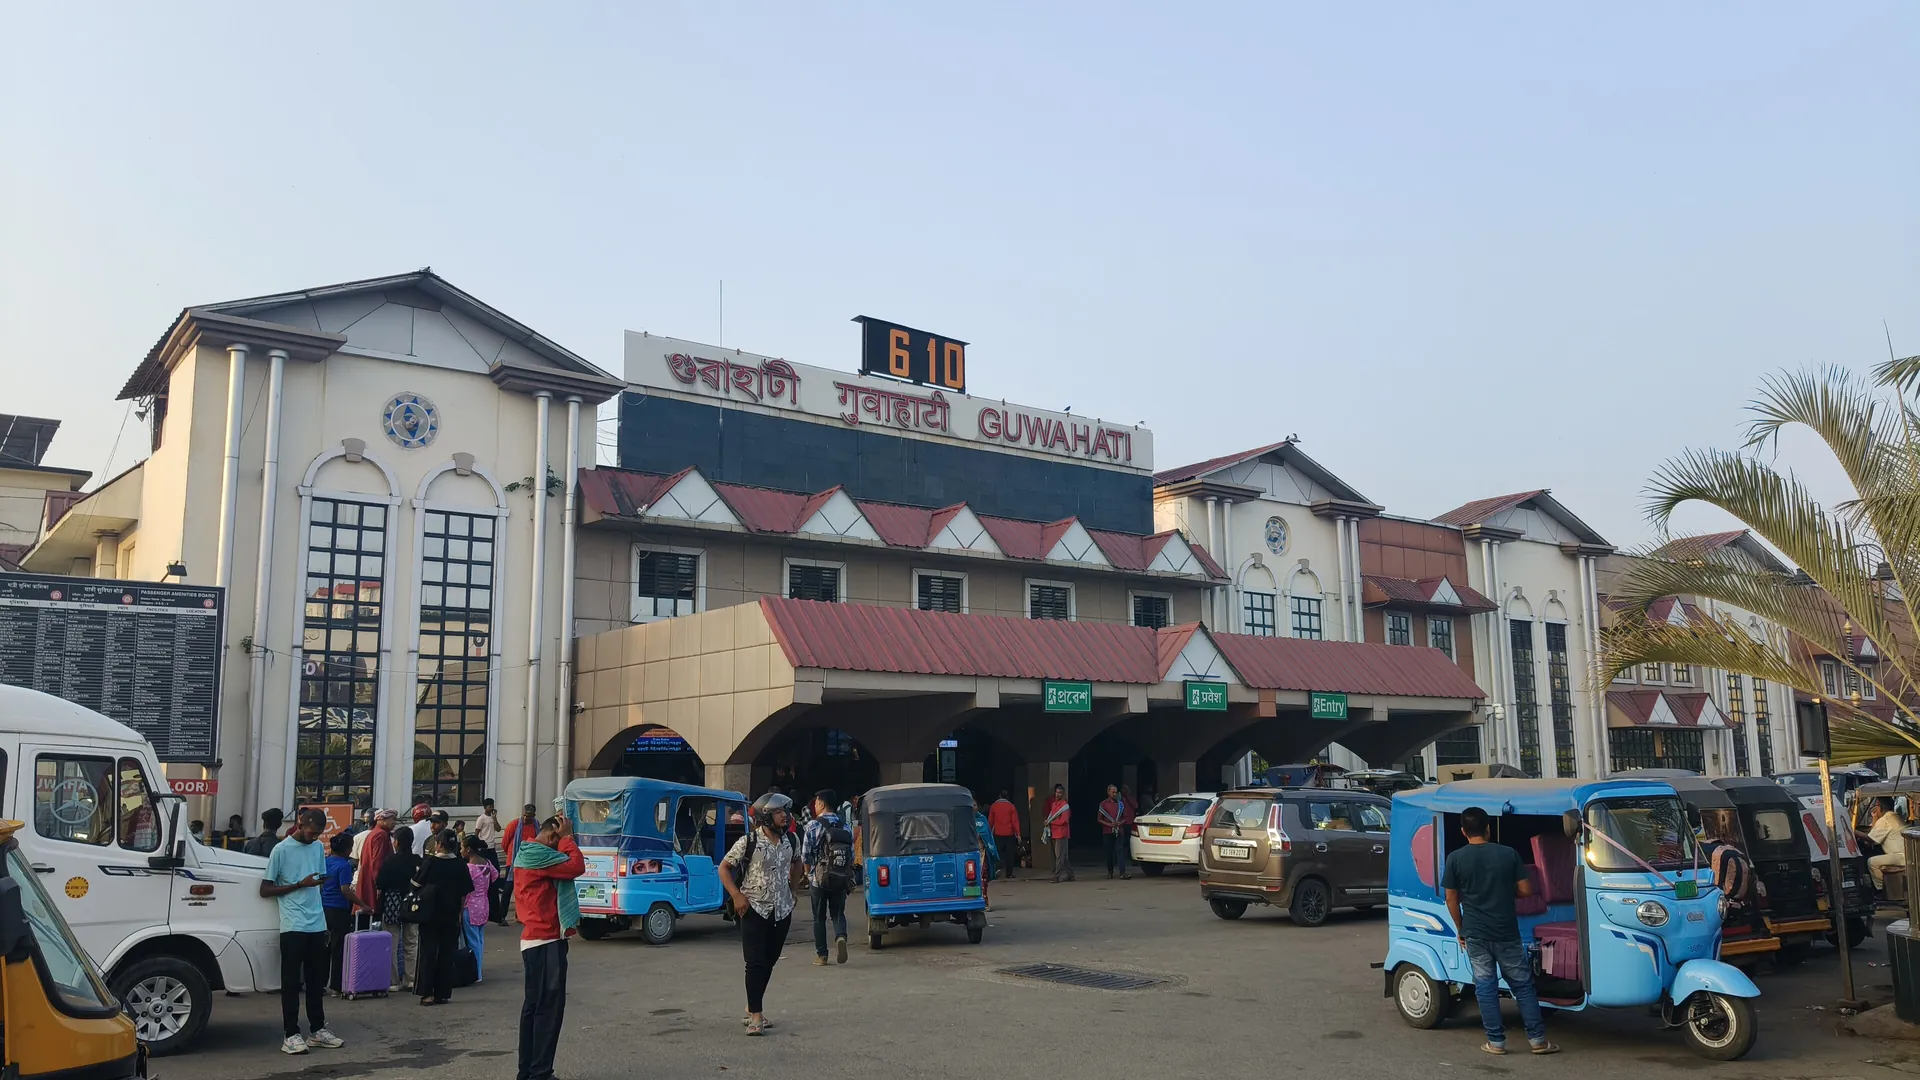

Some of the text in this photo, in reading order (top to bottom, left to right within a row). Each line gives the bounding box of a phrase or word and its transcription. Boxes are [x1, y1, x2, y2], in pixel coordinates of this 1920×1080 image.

[664, 353, 801, 405] গুৱাহাটী
[889, 328, 964, 389] 6 10
[833, 381, 951, 432] गुवाहाटी
[979, 407, 1132, 461] GUWAHATI
[1201, 687, 1222, 704] प्रवेश
[1320, 698, 1344, 716] Entry
